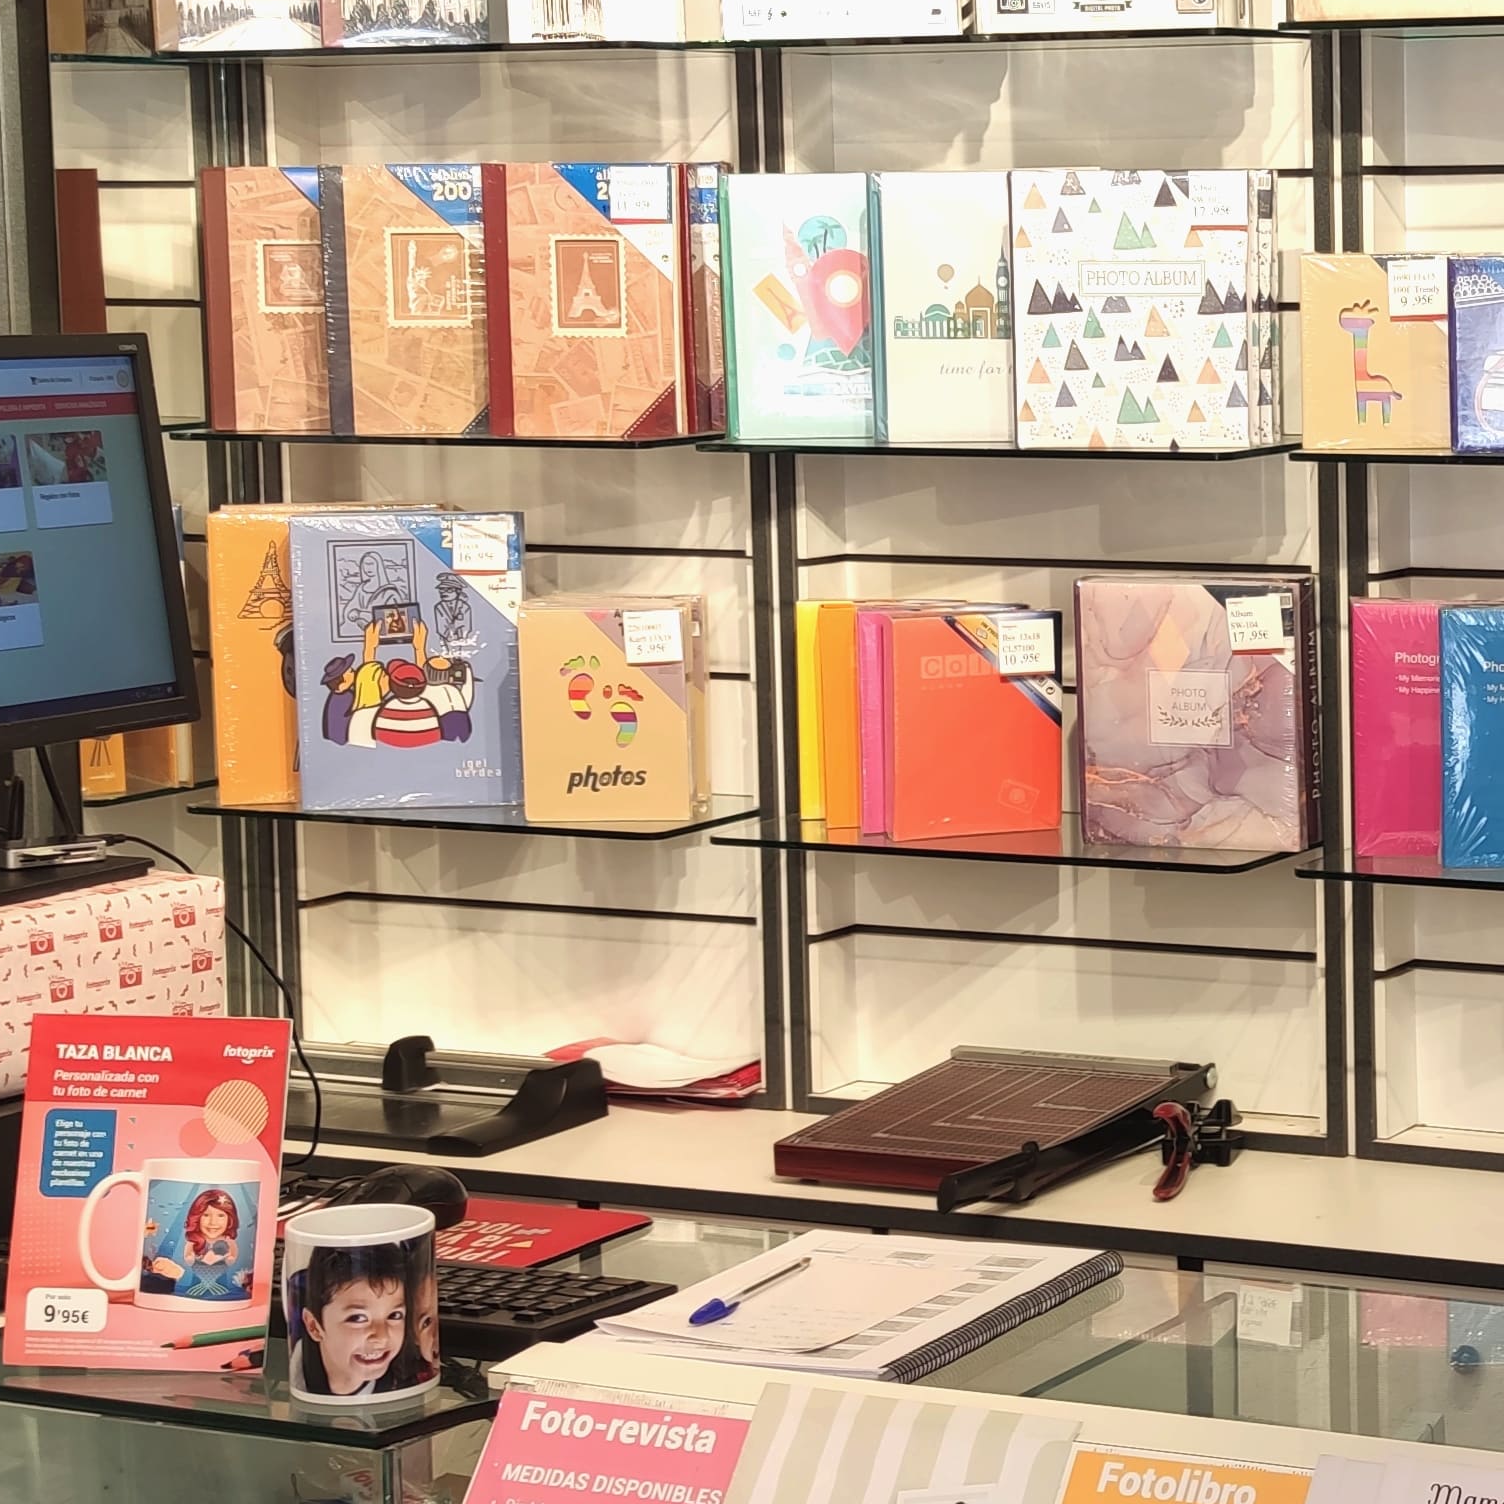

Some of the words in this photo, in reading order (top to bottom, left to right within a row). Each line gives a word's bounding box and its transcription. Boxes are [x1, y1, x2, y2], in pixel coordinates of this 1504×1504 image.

[1086, 269, 1140, 287] PHOTO
[1144, 269, 1197, 287] ALBUM
[566, 764, 647, 794] photos
[56, 1044, 99, 1060] TAZA
[103, 1045, 173, 1062] BLANCA
[520, 1400, 716, 1453] Foto-revista
[502, 1464, 589, 1490] MEDIDAS
